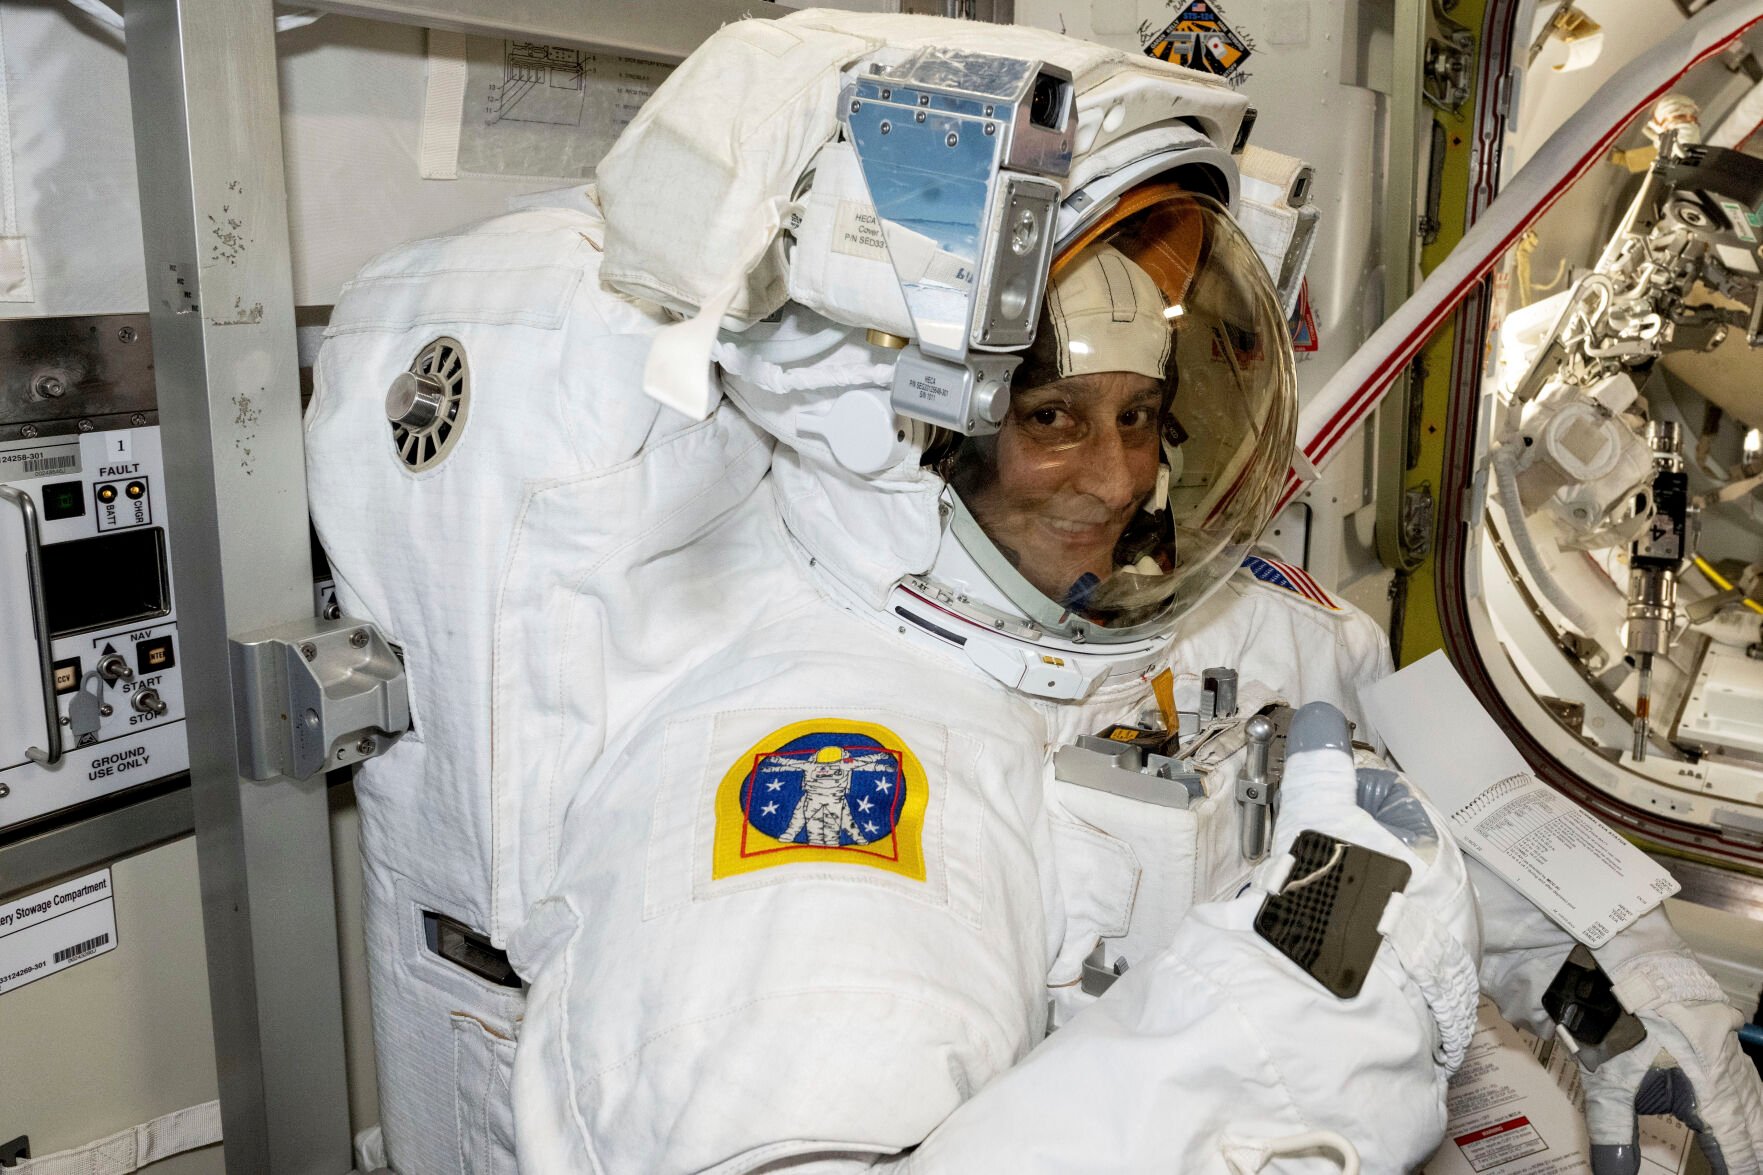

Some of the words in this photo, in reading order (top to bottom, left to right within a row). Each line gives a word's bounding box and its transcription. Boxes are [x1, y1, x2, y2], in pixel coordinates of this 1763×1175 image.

[855, 213, 876, 224] HECA
[117, 440, 125, 451] 1
[99, 463, 140, 476] FAULT
[106, 504, 116, 526] BATT
[134, 500, 144, 524] CHGR
[130, 630, 152, 642] NAV
[122, 675, 163, 693] START
[91, 746, 145, 769] GROUND
[88, 767, 114, 781] USE
[117, 755, 150, 773] ONLY
[0, 913, 13, 926] ery
[15, 902, 52, 919] Stowage
[53, 879, 107, 902] Compartment
